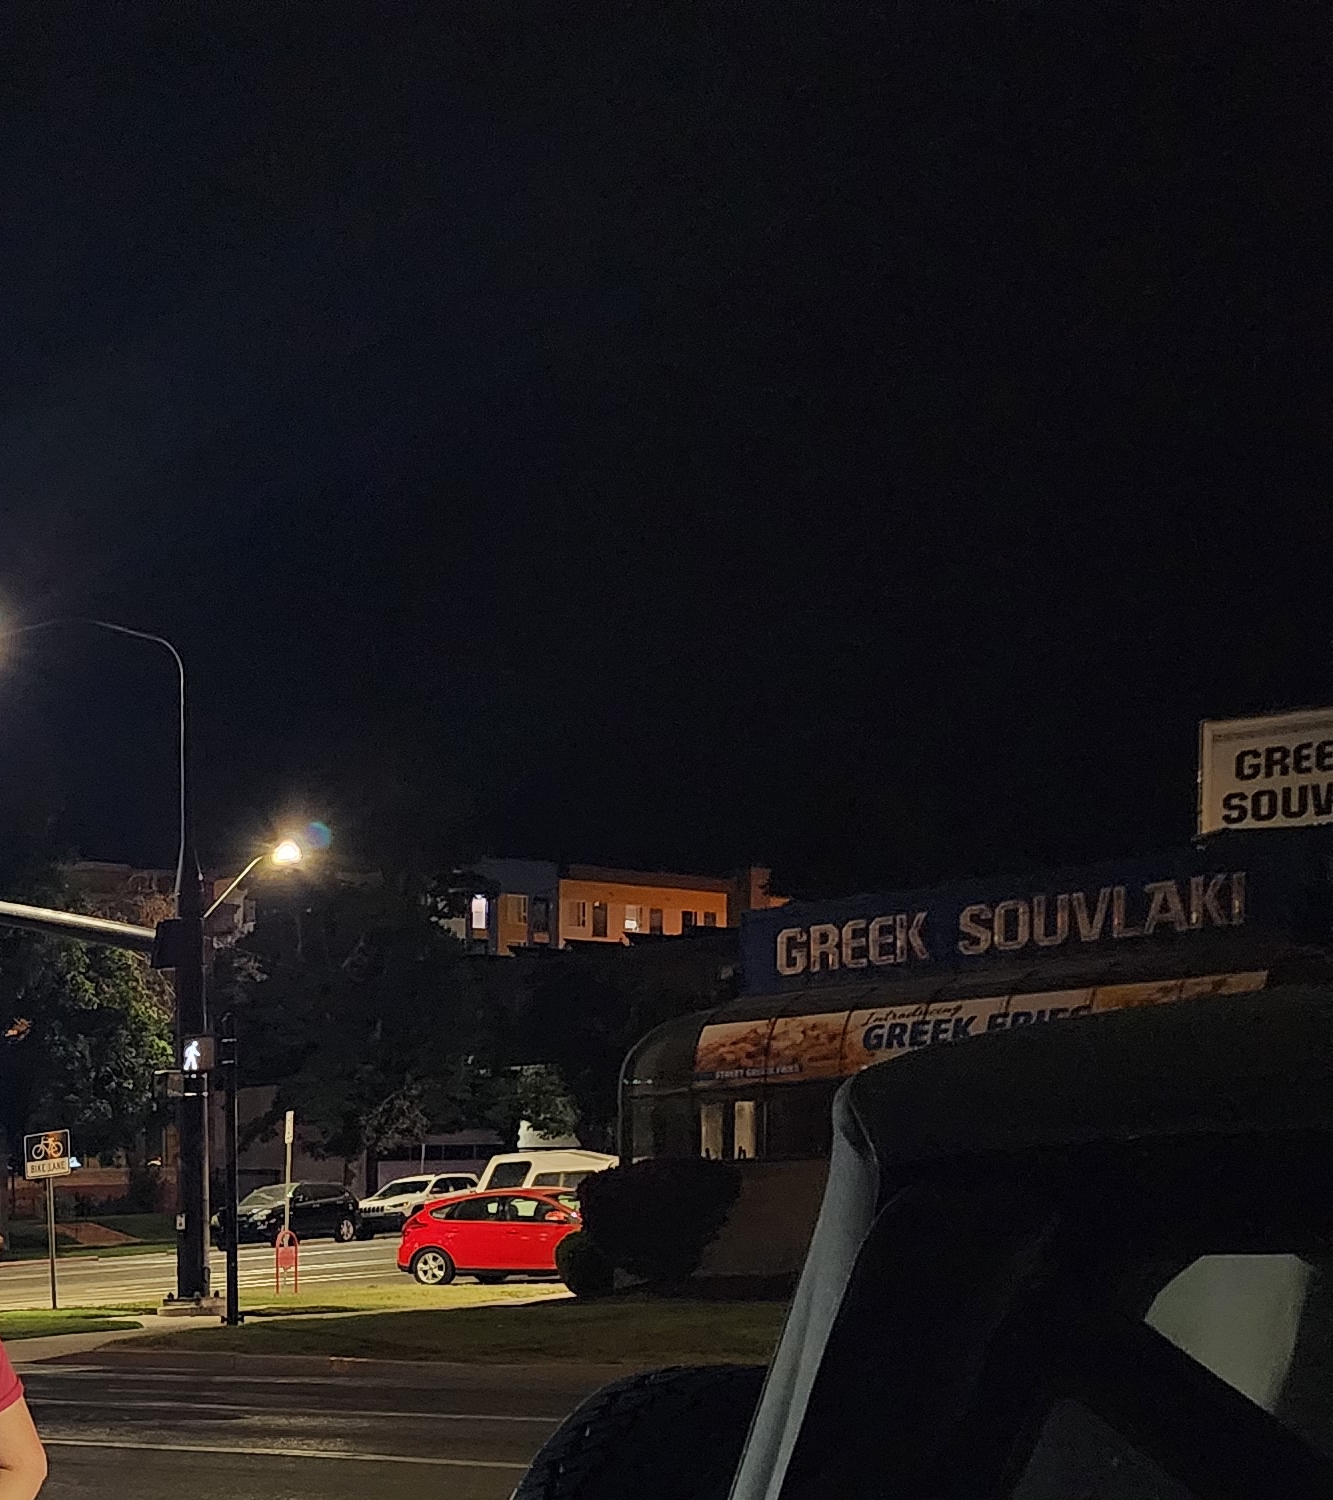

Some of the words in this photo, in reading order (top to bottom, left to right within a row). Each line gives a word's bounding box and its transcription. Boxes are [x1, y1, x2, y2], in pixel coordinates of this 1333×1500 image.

[1234, 739, 1333, 781] GREE
[1221, 781, 1333, 824] SOUV
[776, 911, 929, 976] GREEK
[958, 871, 1247, 955] SOUVLAKI
[863, 1014, 978, 1050] GREEK
[30, 1163, 46, 1174] BIKE
[47, 1160, 66, 1173] LANE
